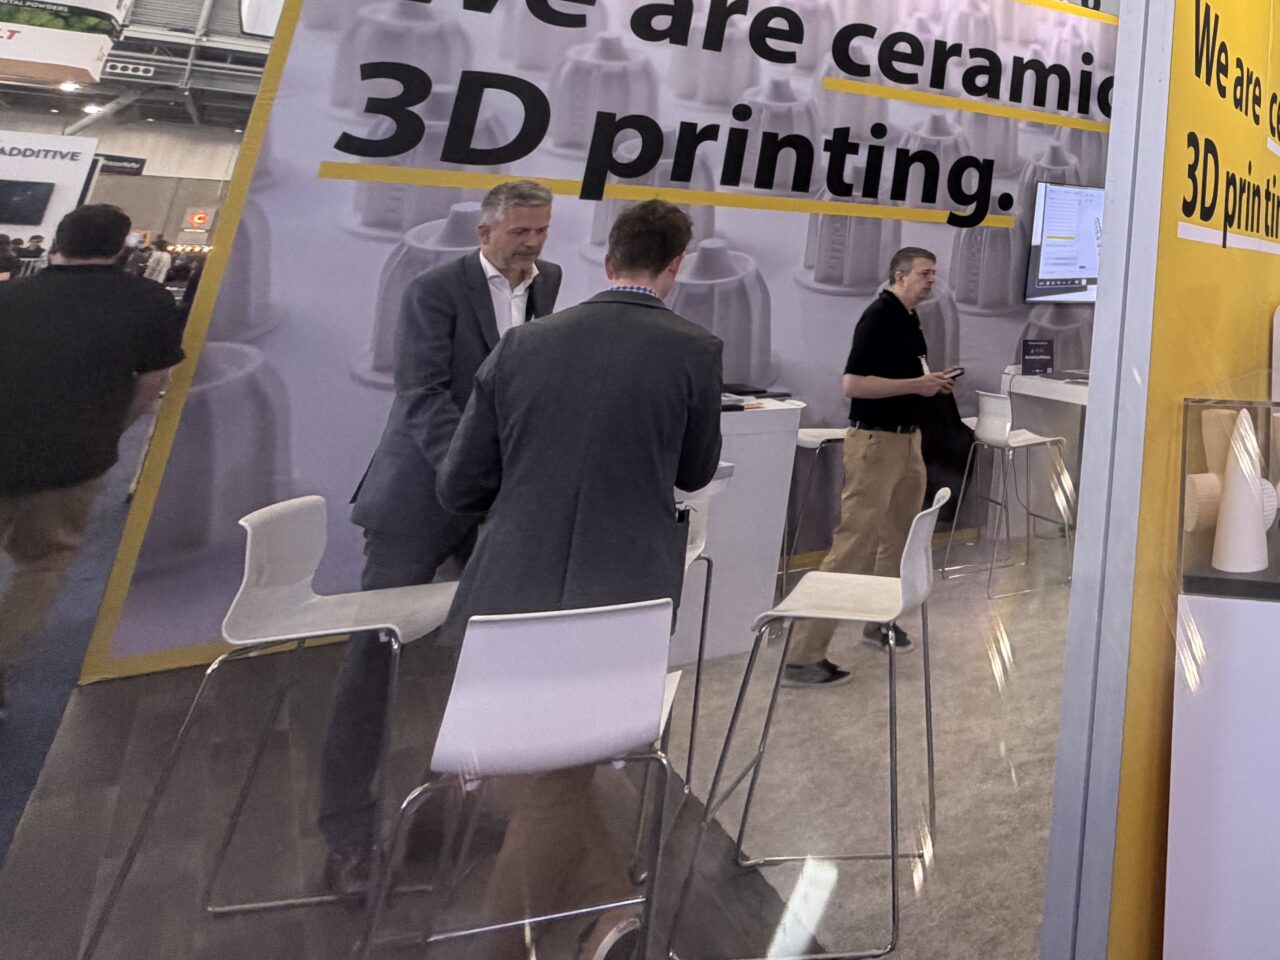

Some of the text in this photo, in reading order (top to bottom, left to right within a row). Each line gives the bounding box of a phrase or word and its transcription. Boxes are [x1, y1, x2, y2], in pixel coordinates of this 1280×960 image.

[25, 1, 69, 13] POWDERS
[1233, 56, 1262, 126] are
[333, 61, 1014, 227] 3D printing.
[1182, 131, 1219, 222] 3D
